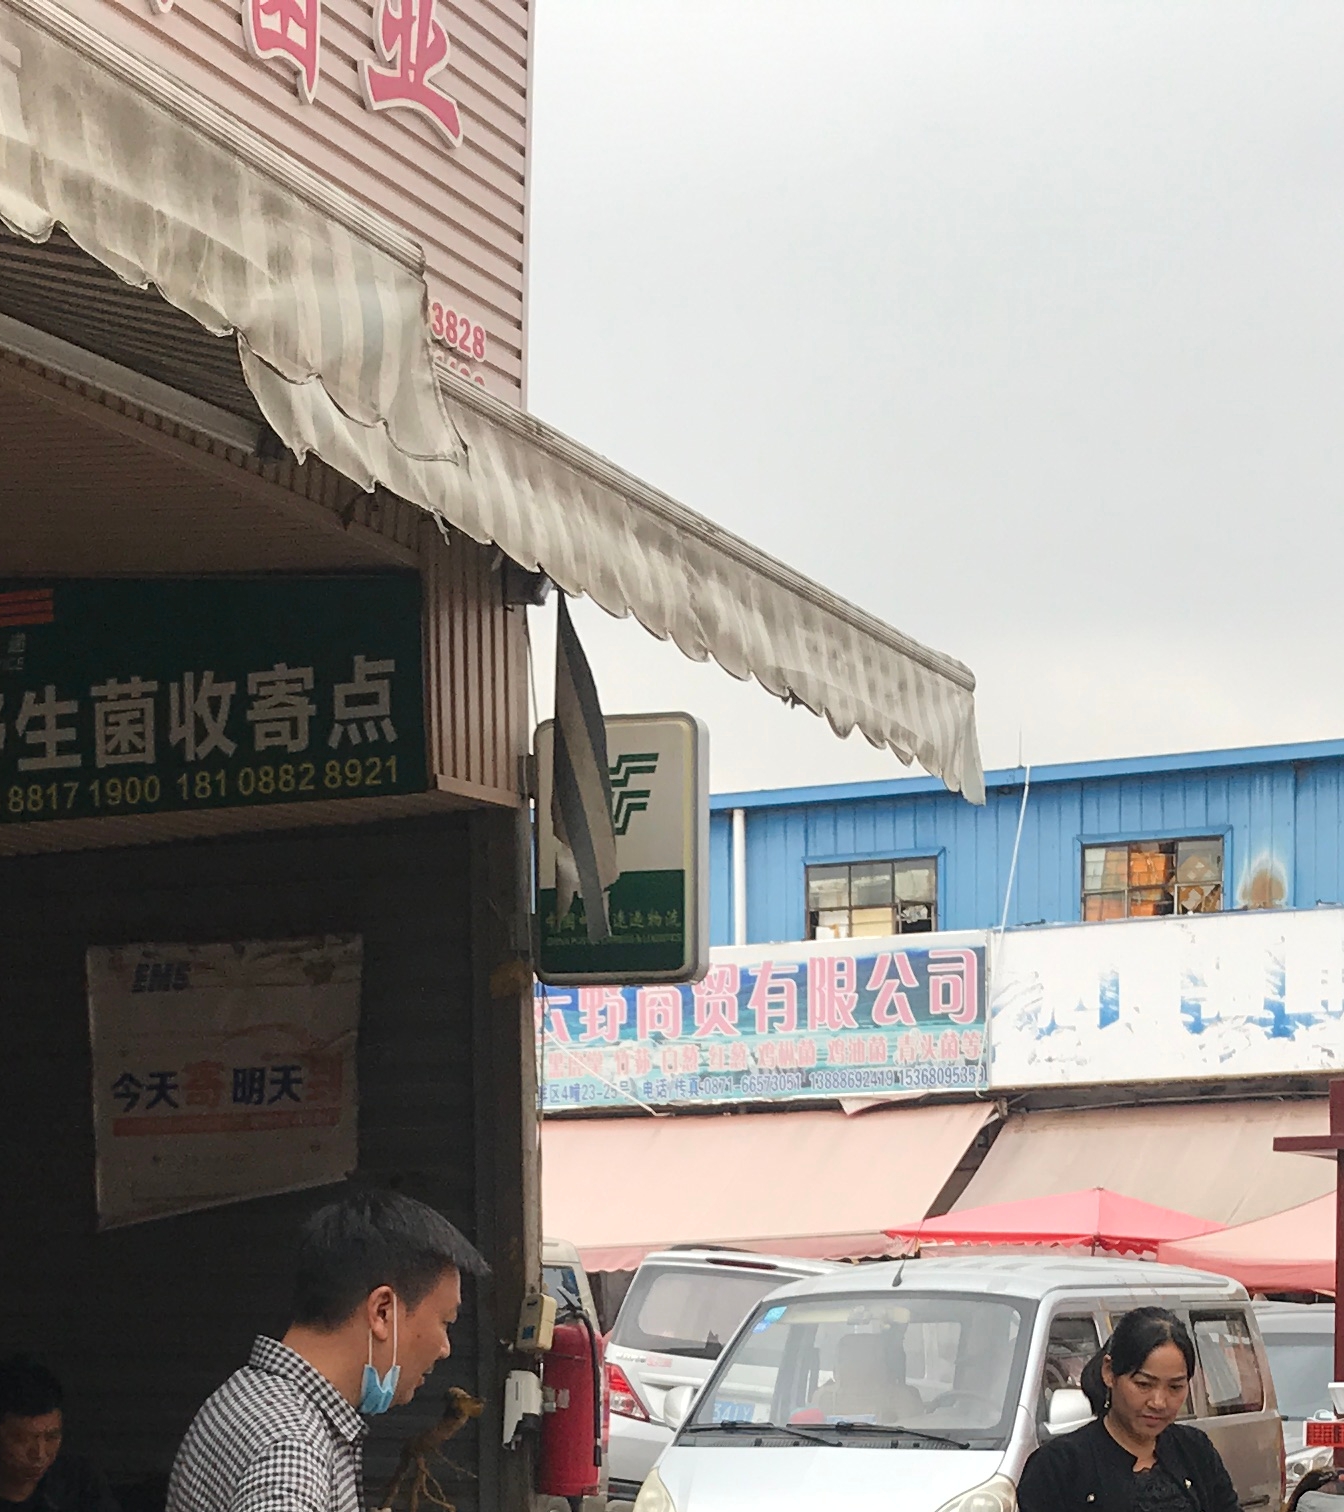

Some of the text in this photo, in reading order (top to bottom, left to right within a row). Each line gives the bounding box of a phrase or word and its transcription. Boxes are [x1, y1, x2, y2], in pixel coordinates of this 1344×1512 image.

[7, 781, 78, 813] 8817
[89, 775, 161, 808] 1900
[176, 770, 227, 800] 181
[237, 763, 316, 797] 0882
[323, 754, 399, 789] 8921
[131, 960, 191, 994] EMS
